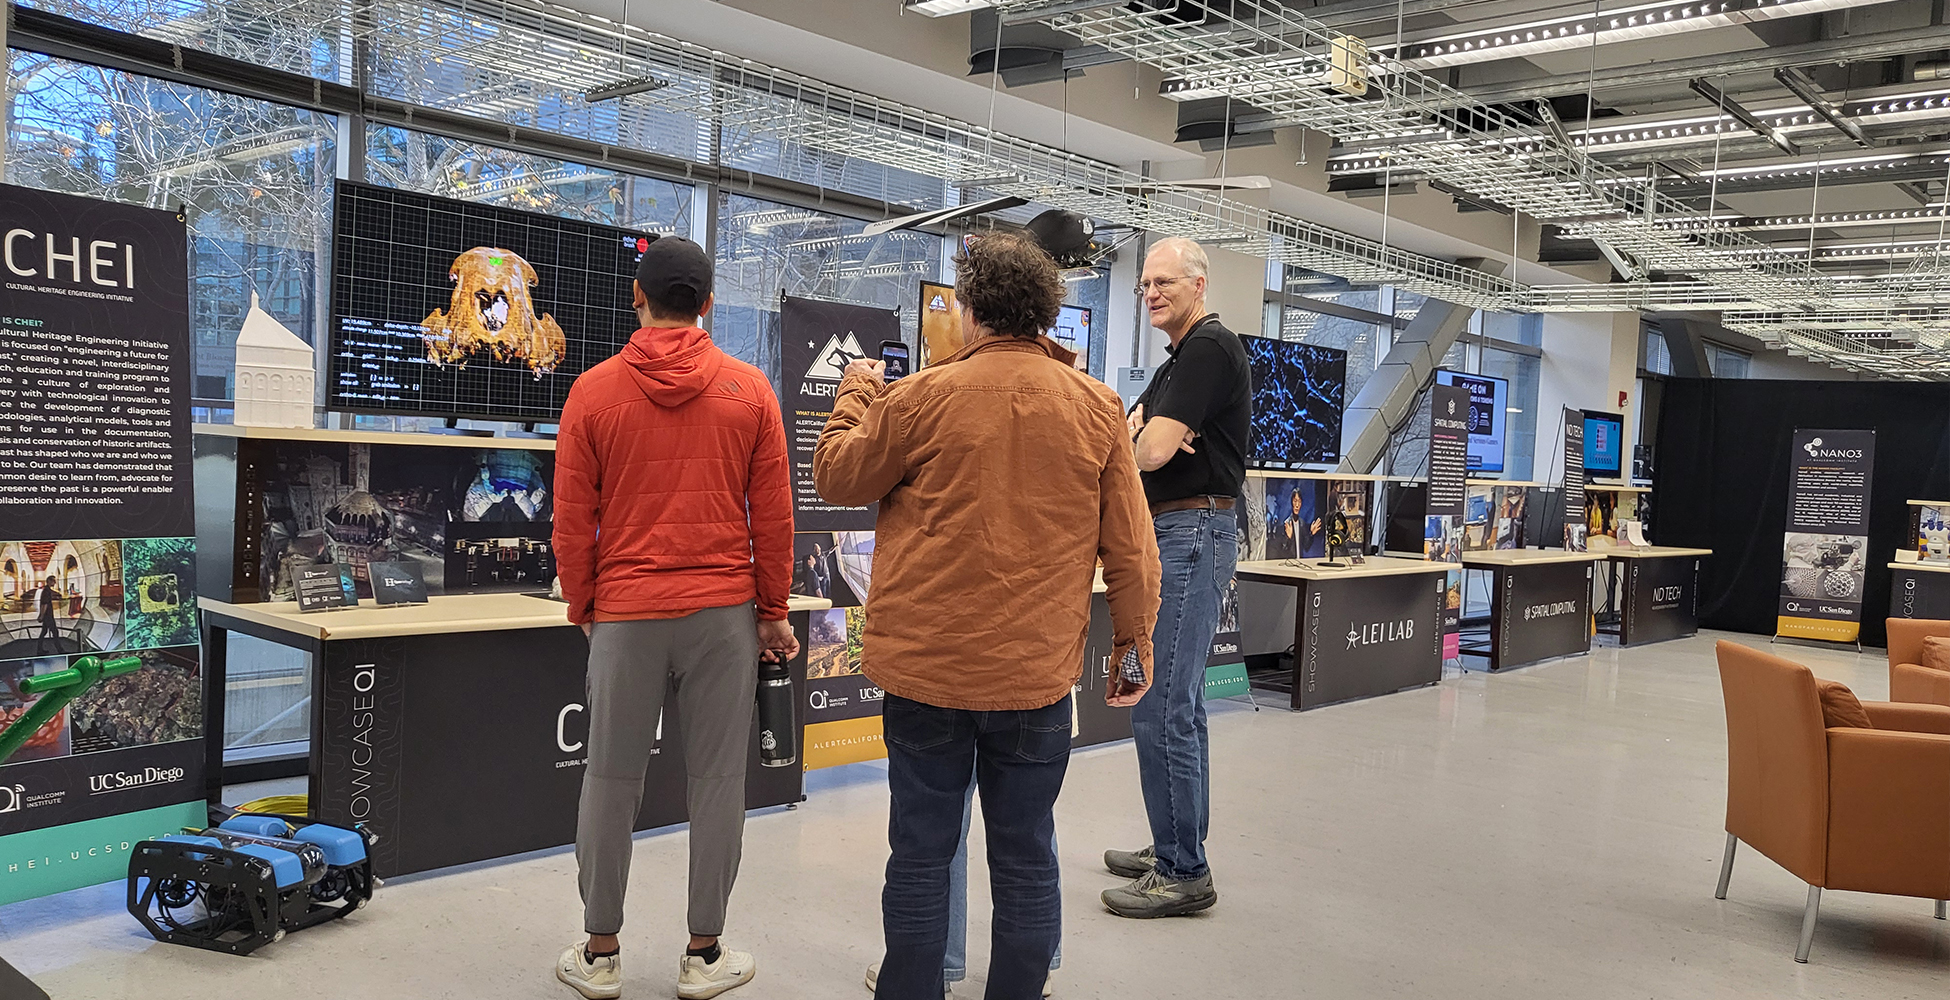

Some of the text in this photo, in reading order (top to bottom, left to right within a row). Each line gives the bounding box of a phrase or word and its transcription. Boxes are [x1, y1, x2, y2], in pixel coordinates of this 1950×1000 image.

[4, 228, 134, 289] CHEI
[6, 282, 133, 302] CULTURAL HERITAGE ENGINEERING INITIATIVE
[15, 318, 43, 327] CHEI?
[32, 331, 72, 342] Heritage
[76, 335, 129, 347] Engineering
[132, 340, 169, 349] Initiative
[11, 340, 48, 350] focused
[64, 346, 121, 358] "engineering
[130, 349, 156, 359] future
[21, 354, 59, 365] creating
[72, 358, 98, 367] novel,
[102, 359, 169, 373] interdisciplinary
[16, 365, 63, 375] education
[85, 370, 120, 380] training
[122, 374, 159, 383] program
[37, 379, 70, 387] culture
[97, 384, 145, 394] exploration
[800, 382, 838, 397] ALERT
[22, 389, 42, 398] with
[47, 391, 108, 403] technological
[112, 395, 157, 404] innovation
[44, 402, 104, 414] development
[127, 407, 171, 417] diagnostic
[49, 415, 92, 425] analytical
[96, 417, 129, 426] models,
[105, 429, 172, 438] documentation,
[33, 438, 90, 447] conservation
[103, 440, 134, 448] historic
[136, 441, 172, 449] artifacts.
[35, 450, 68, 460] shaped
[1820, 450, 1862, 458] NANO3
[96, 474, 119, 482] from,
[60, 486, 79, 495] past
[101, 485, 139, 495] powerful
[1653, 586, 1682, 602] ND TECH
[1531, 600, 1576, 619] SPATIAL COMPUTING
[1362, 619, 1414, 645] LEI LAB
[859, 688, 872, 699] UC
[350, 664, 375, 824] OWCASEQI
[555, 760, 581, 768] CULTURAL
[89, 766, 184, 792] UC San Diego
[26, 790, 65, 802] QUALCOMM
[27, 798, 62, 808] INSTITUTE
